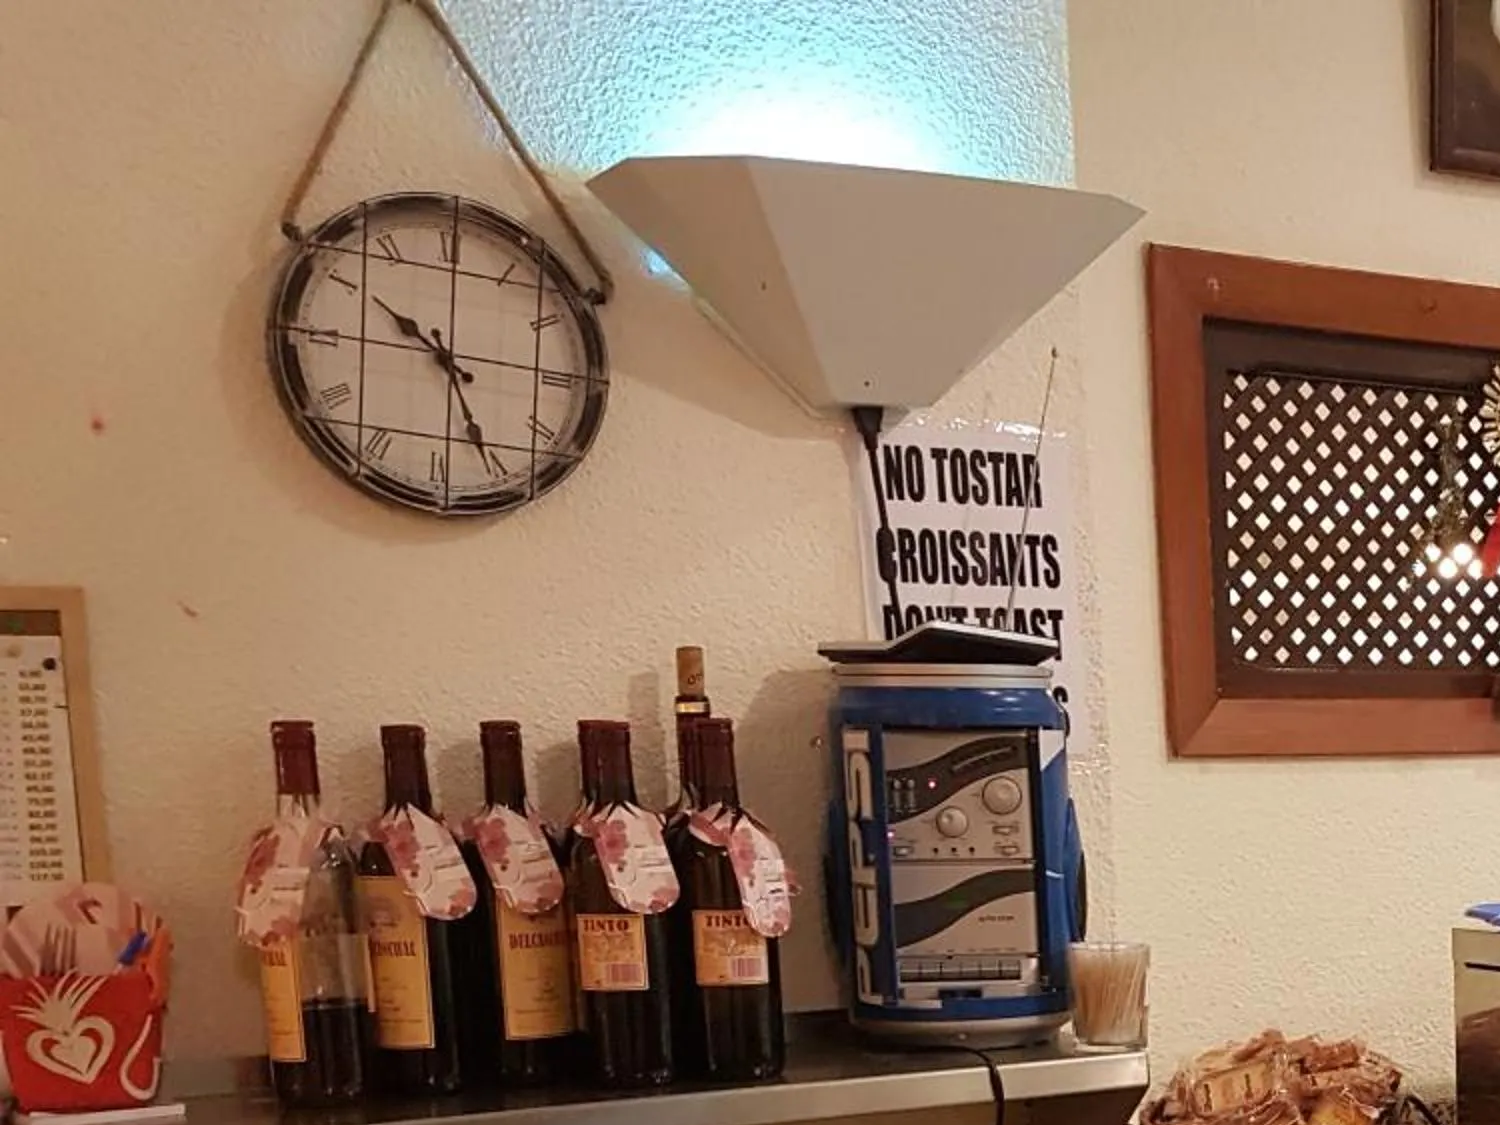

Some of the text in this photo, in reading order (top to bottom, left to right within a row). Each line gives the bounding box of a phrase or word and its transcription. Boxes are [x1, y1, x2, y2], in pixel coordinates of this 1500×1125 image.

[883, 445, 1043, 508] NO TOSTAR
[883, 604, 969, 641] DO
[583, 919, 629, 932] TINTO
